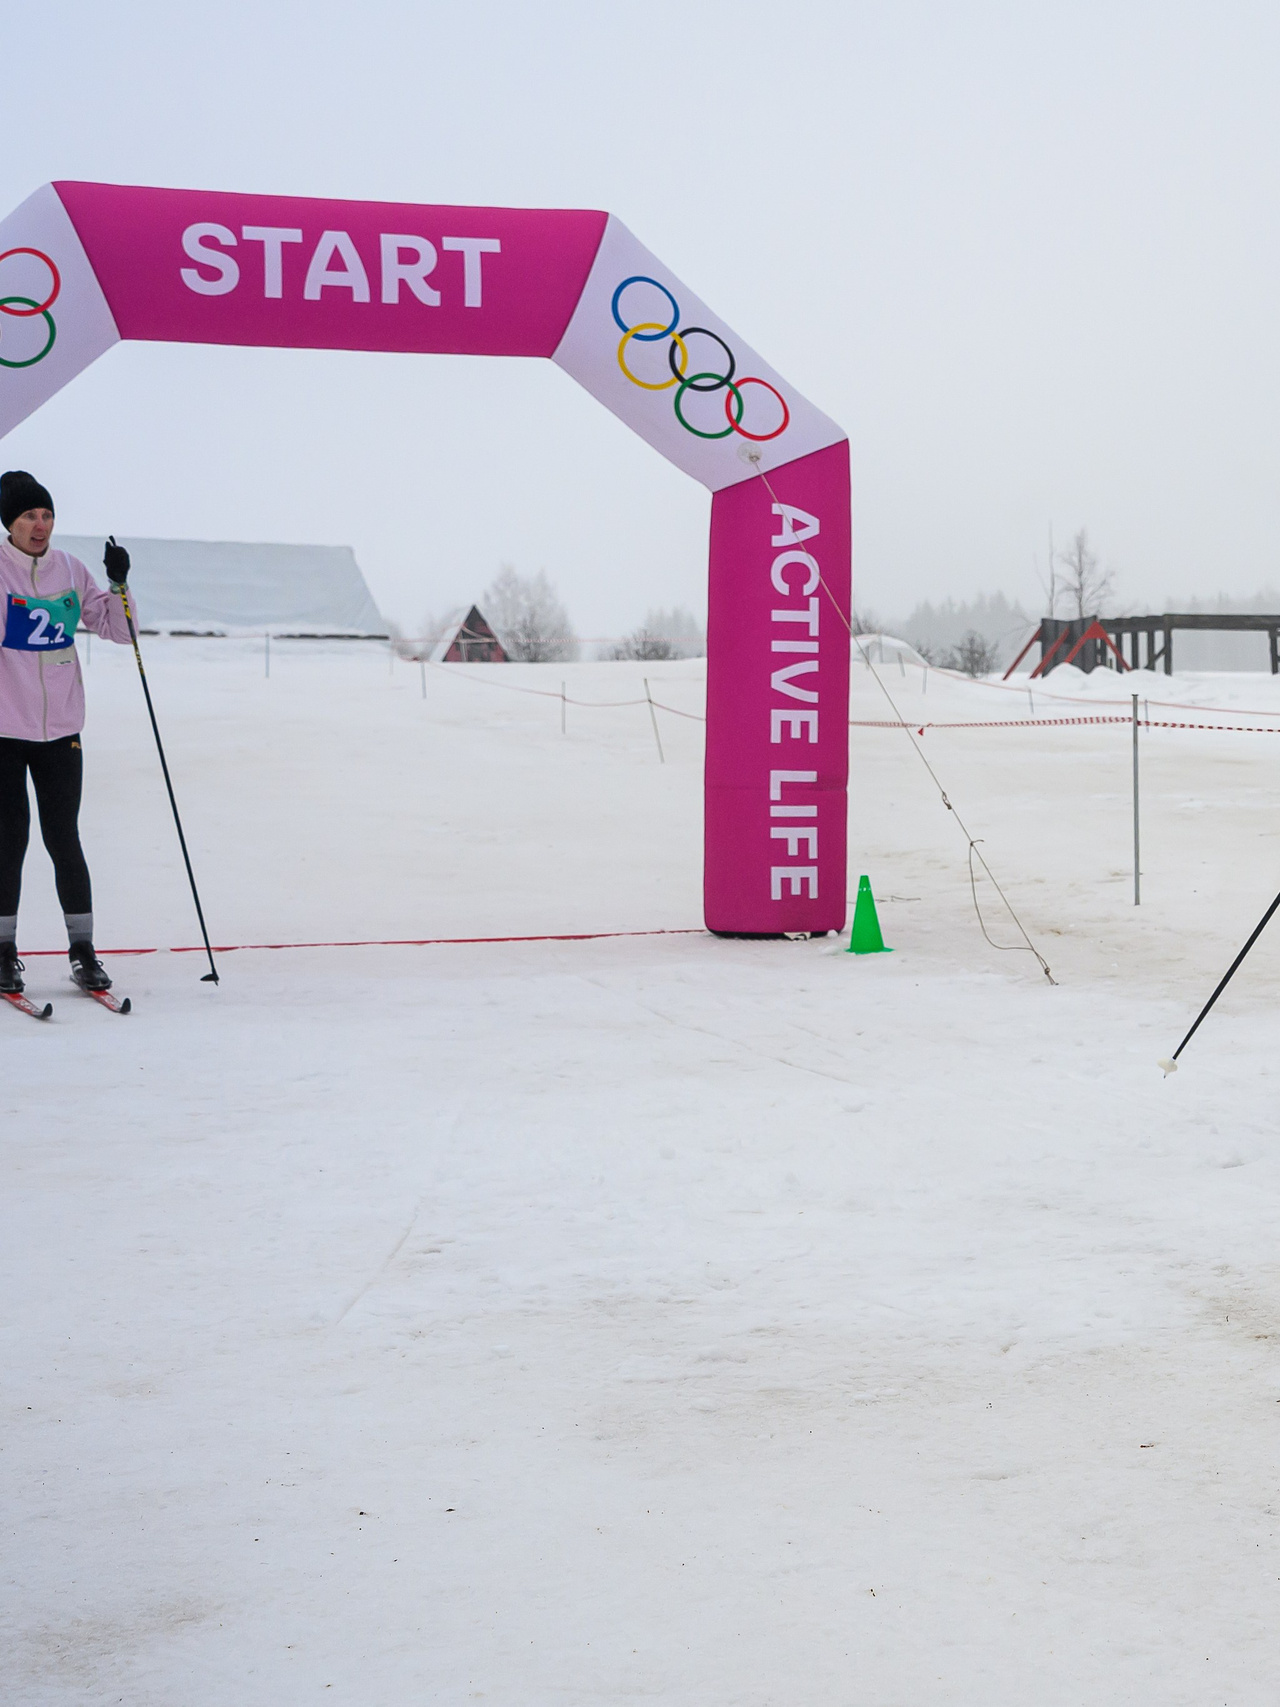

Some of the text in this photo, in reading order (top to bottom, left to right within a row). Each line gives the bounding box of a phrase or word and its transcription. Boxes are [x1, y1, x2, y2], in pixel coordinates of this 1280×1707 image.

[180, 222, 502, 308] START
[27, 607, 65, 645] 2.2
[769, 502, 821, 901] ACTIVE LIFE
